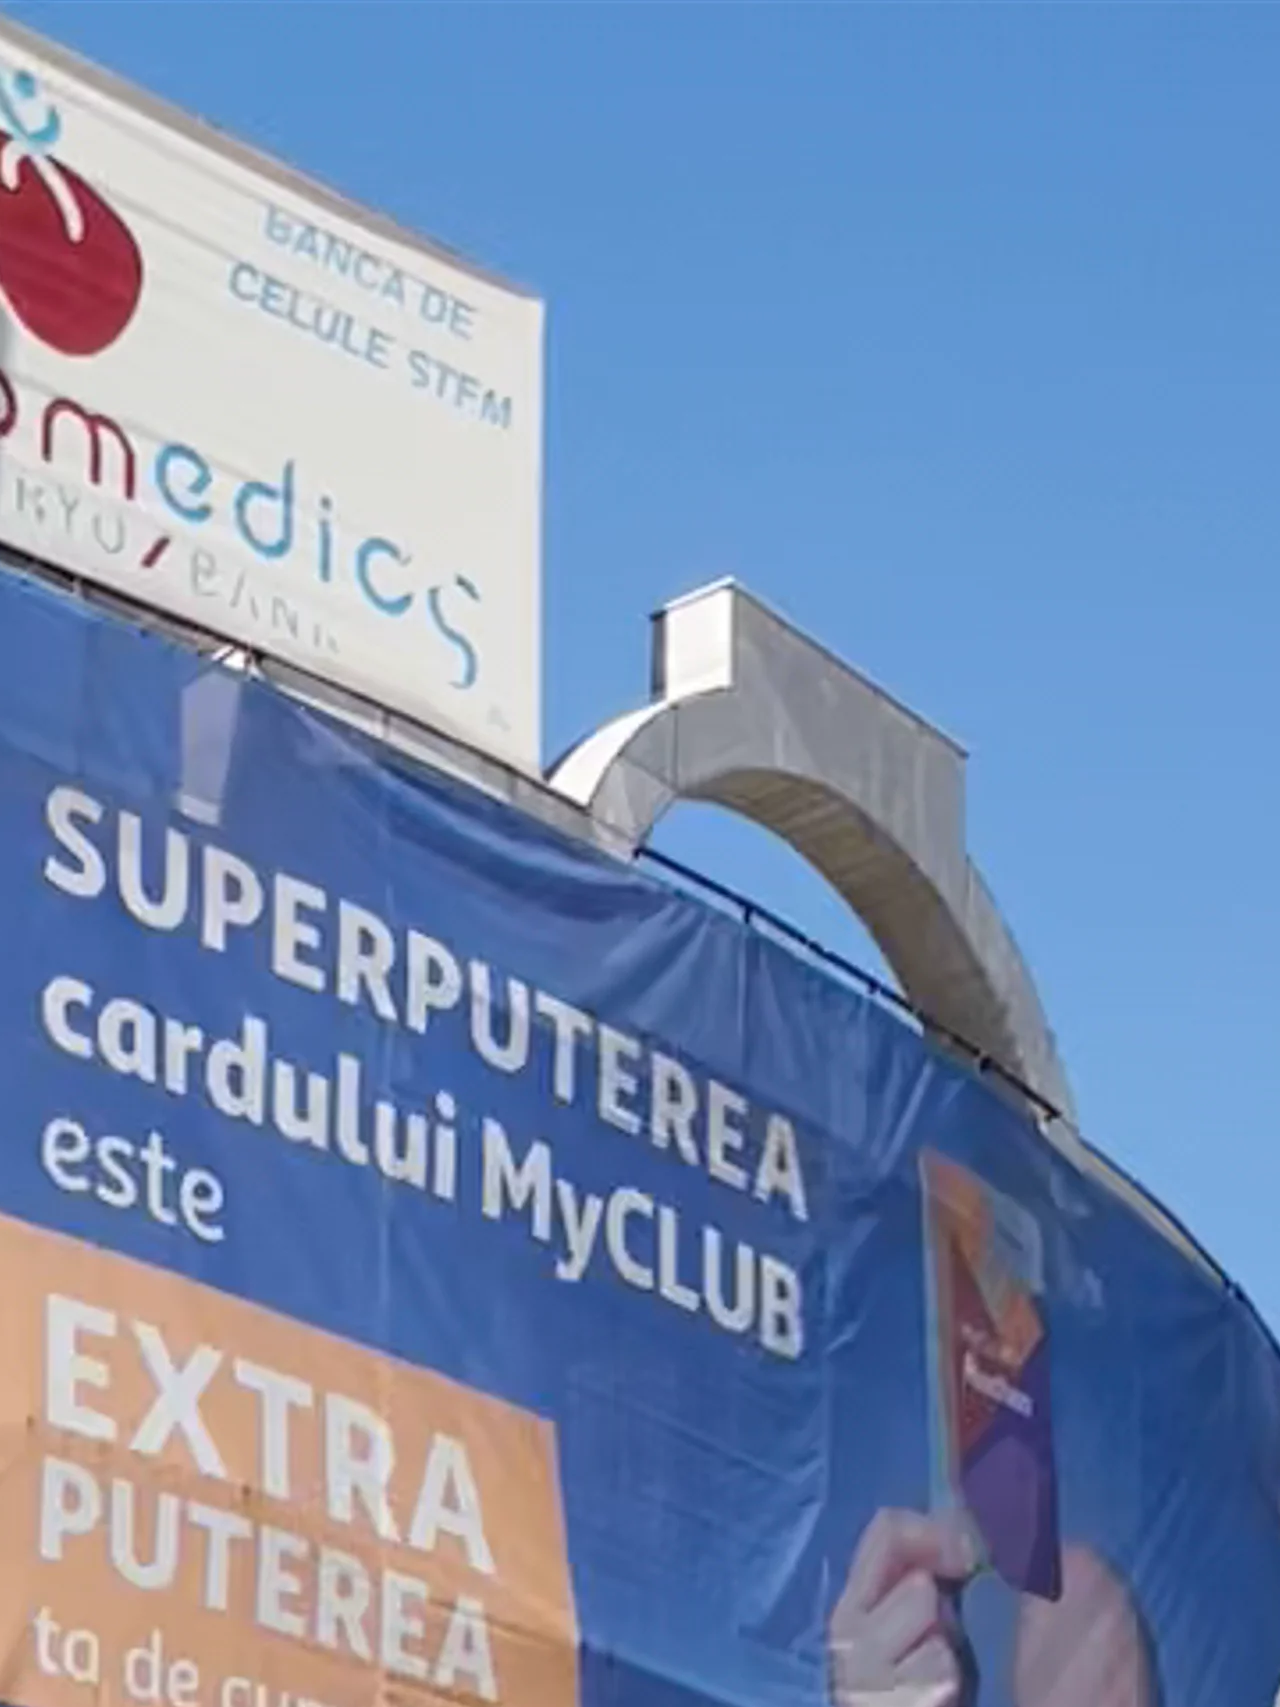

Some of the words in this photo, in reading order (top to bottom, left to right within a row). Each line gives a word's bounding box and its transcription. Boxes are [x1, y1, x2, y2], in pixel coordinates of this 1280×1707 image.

[228, 262, 397, 370] CELULE
[263, 203, 407, 308] BANCA
[420, 283, 480, 342] DE
[43, 784, 810, 1223] SUPERPUTEREA
[41, 1117, 226, 1243] este
[42, 976, 458, 1202] cardului
[481, 1116, 806, 1363] MyCLUB
[45, 1292, 497, 1576] EXTRA
[32, 1606, 101, 1685] ta
[37, 1457, 500, 1704] PUTEREA
